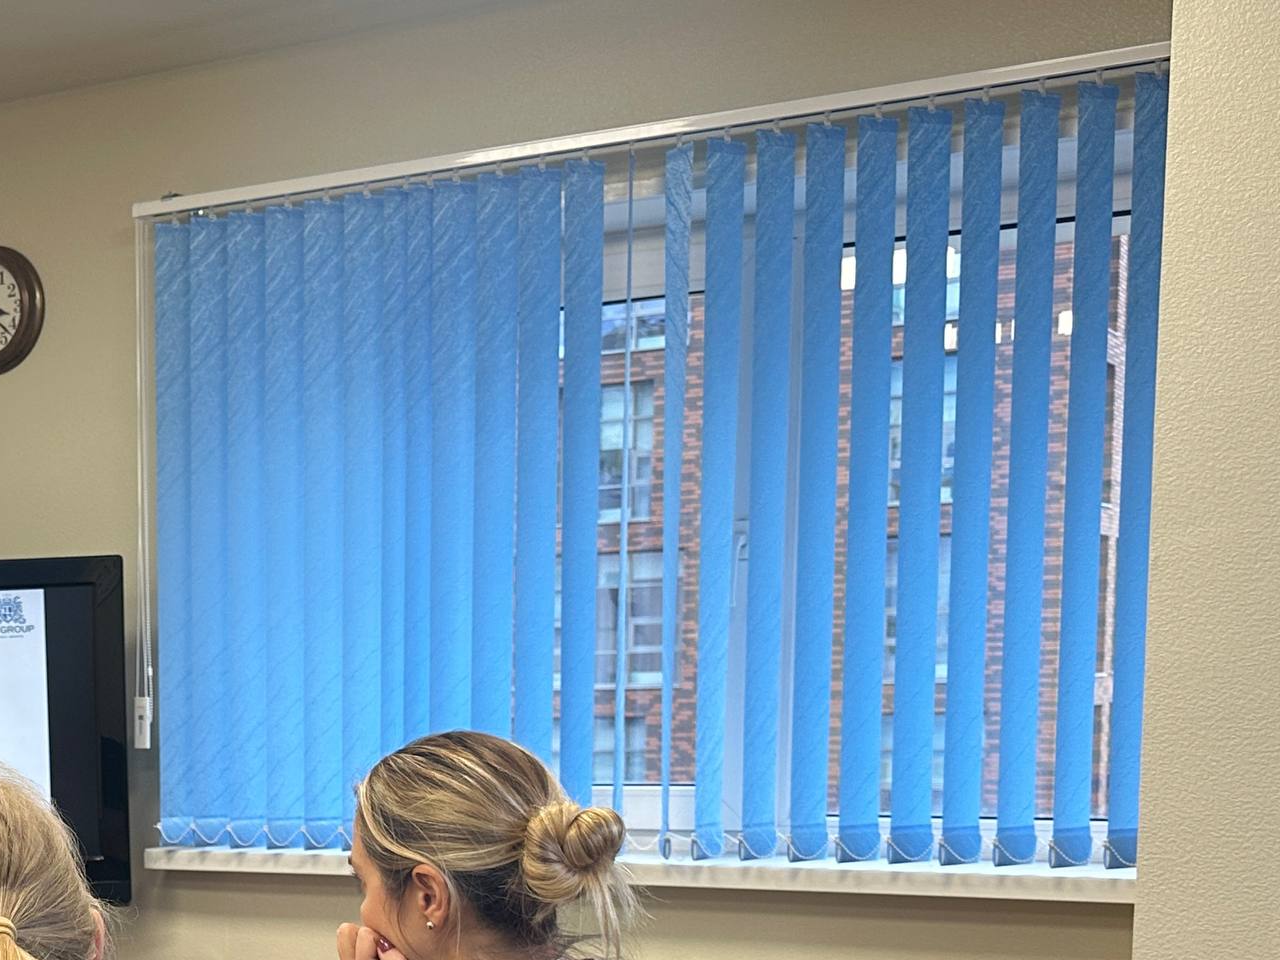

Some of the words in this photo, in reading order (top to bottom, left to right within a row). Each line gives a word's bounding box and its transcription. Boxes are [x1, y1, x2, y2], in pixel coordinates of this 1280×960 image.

[0, 271, 5, 286] 1
[7, 283, 16, 298] 2
[8, 316, 17, 330] 4
[0, 332, 8, 346] 5
[0, 625, 34, 633] GROUP
